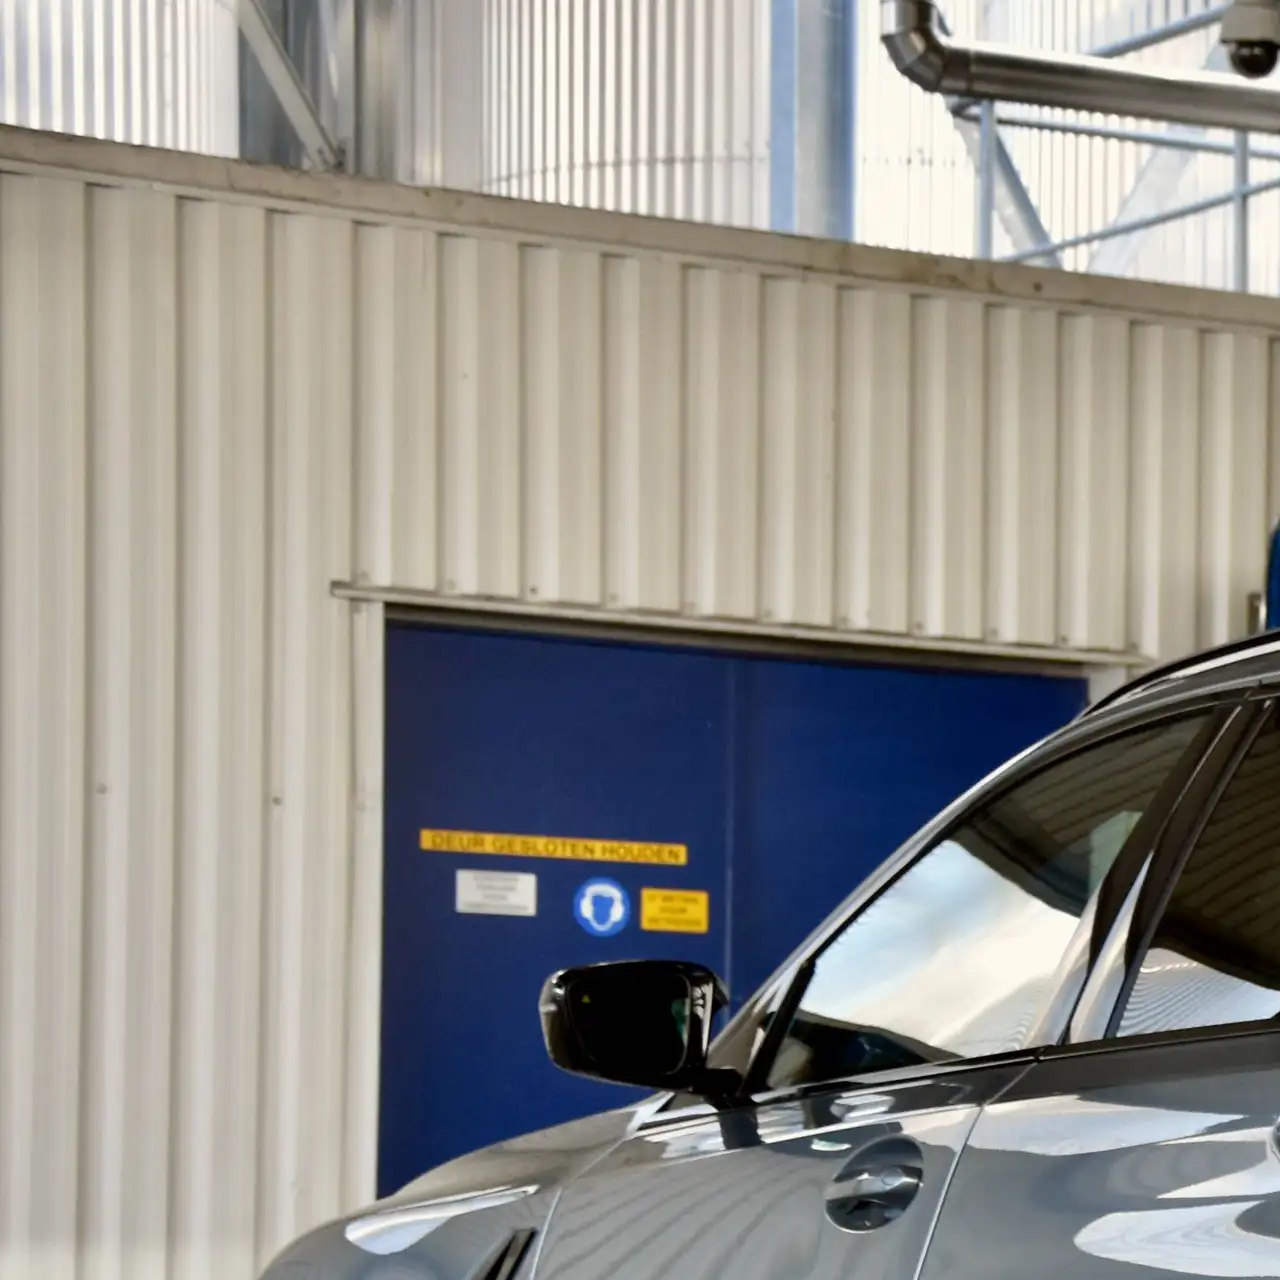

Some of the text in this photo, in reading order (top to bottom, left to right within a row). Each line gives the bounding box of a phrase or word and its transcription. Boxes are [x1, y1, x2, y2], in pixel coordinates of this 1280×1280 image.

[431, 832, 680, 862] DEUR GESLOTEN HOUDEN
